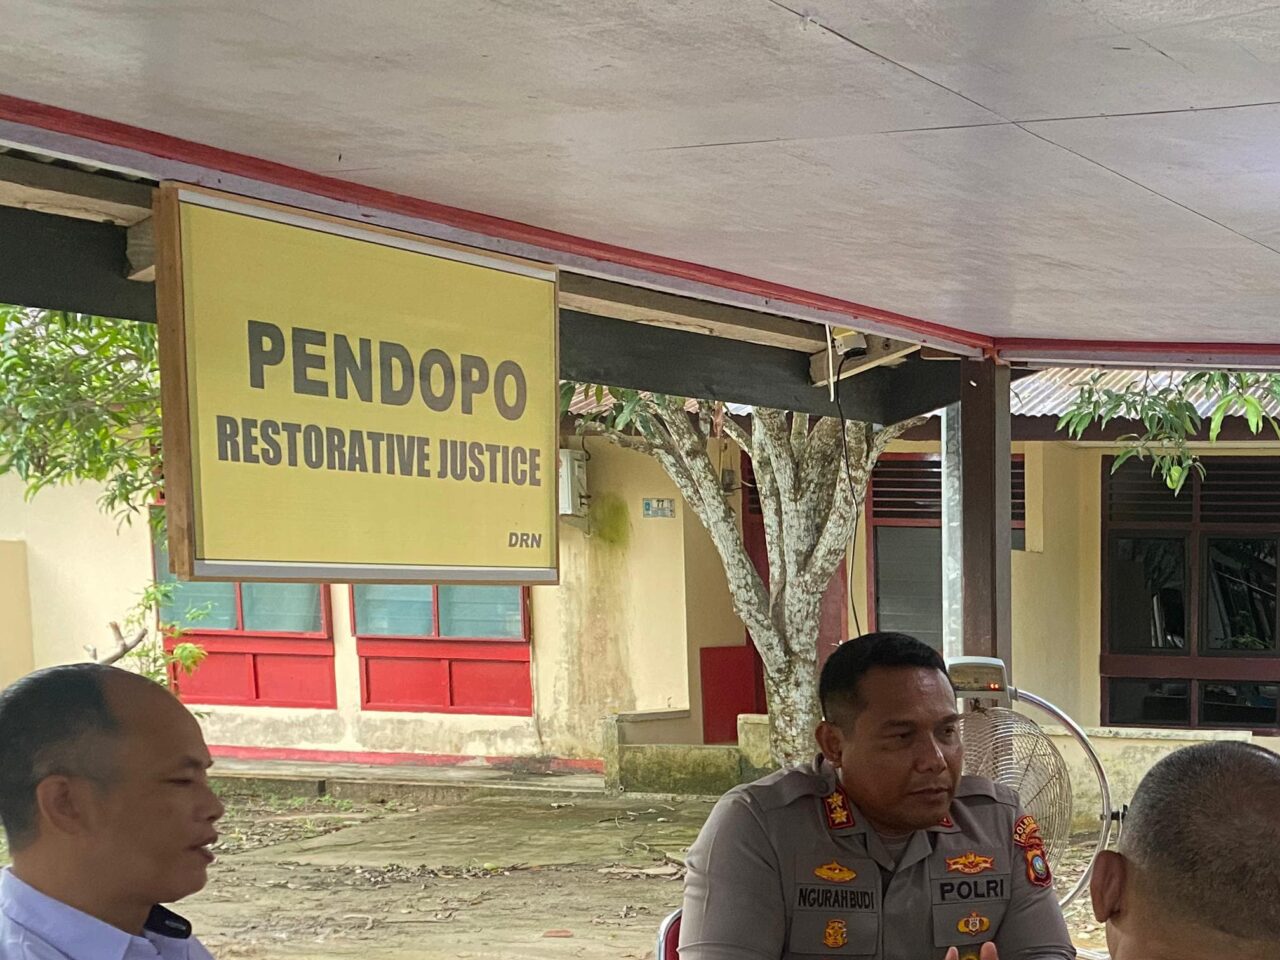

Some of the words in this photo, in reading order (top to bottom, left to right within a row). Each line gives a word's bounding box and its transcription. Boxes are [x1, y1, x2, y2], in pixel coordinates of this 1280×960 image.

[247, 319, 527, 421] PENDOPO
[216, 414, 431, 478] RESTORATIVE
[437, 438, 542, 487] JUSTICE
[508, 531, 542, 549] DRN
[940, 879, 1004, 901] POLRI
